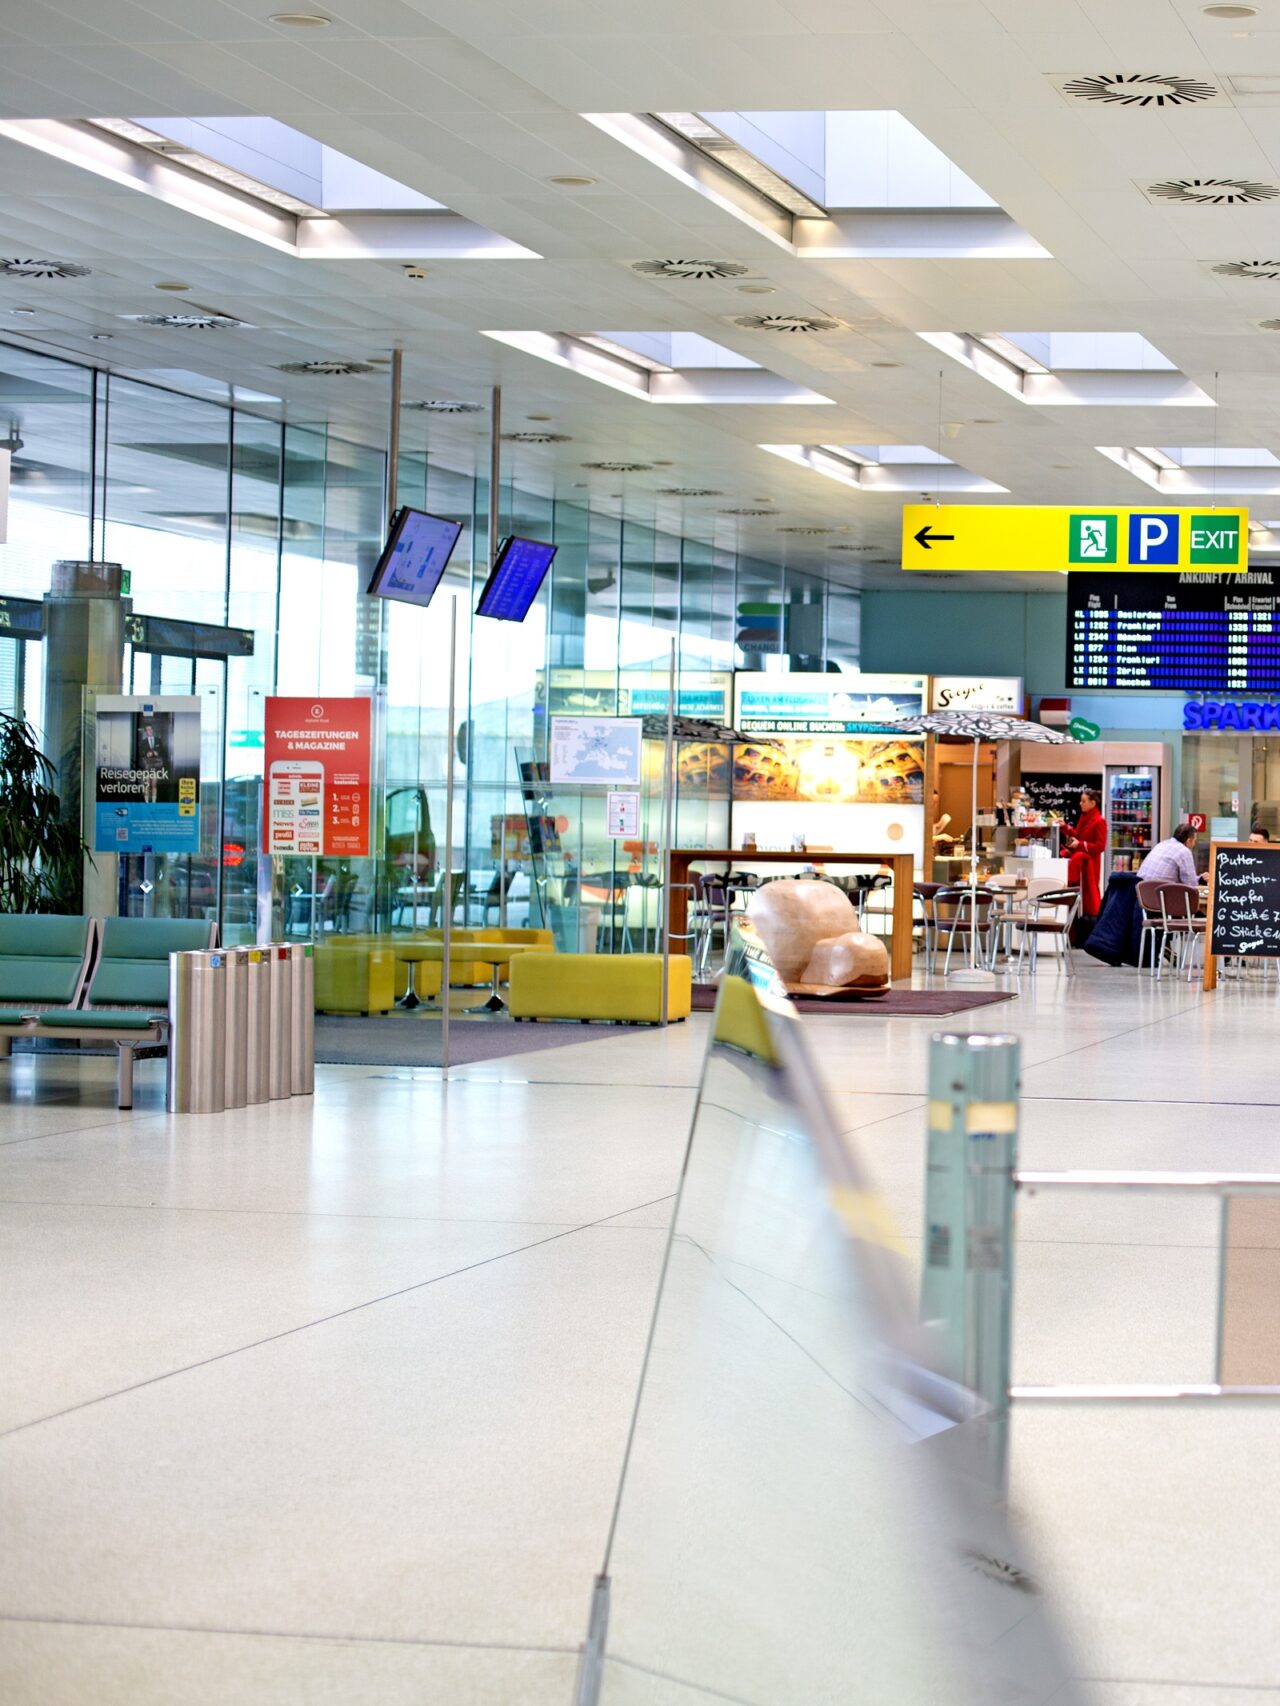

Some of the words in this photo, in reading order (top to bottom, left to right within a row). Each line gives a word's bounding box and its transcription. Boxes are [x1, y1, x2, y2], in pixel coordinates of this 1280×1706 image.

[1140, 518, 1168, 561] P
[1192, 530, 1238, 550] EXIT
[1179, 573, 1223, 585] ANKUNFT
[1234, 572, 1274, 585] ARRIVAL
[776, 720, 808, 732] ONLINE
[274, 730, 358, 740] TAGESZEITUNGEN
[288, 742, 294, 750] &
[296, 742, 346, 751] MAGAZINE
[100, 767, 168, 782] Reisegepäck
[100, 782, 150, 794] verloren?
[1218, 890, 1264, 906] Krapfen
[1214, 924, 1226, 938] 10
